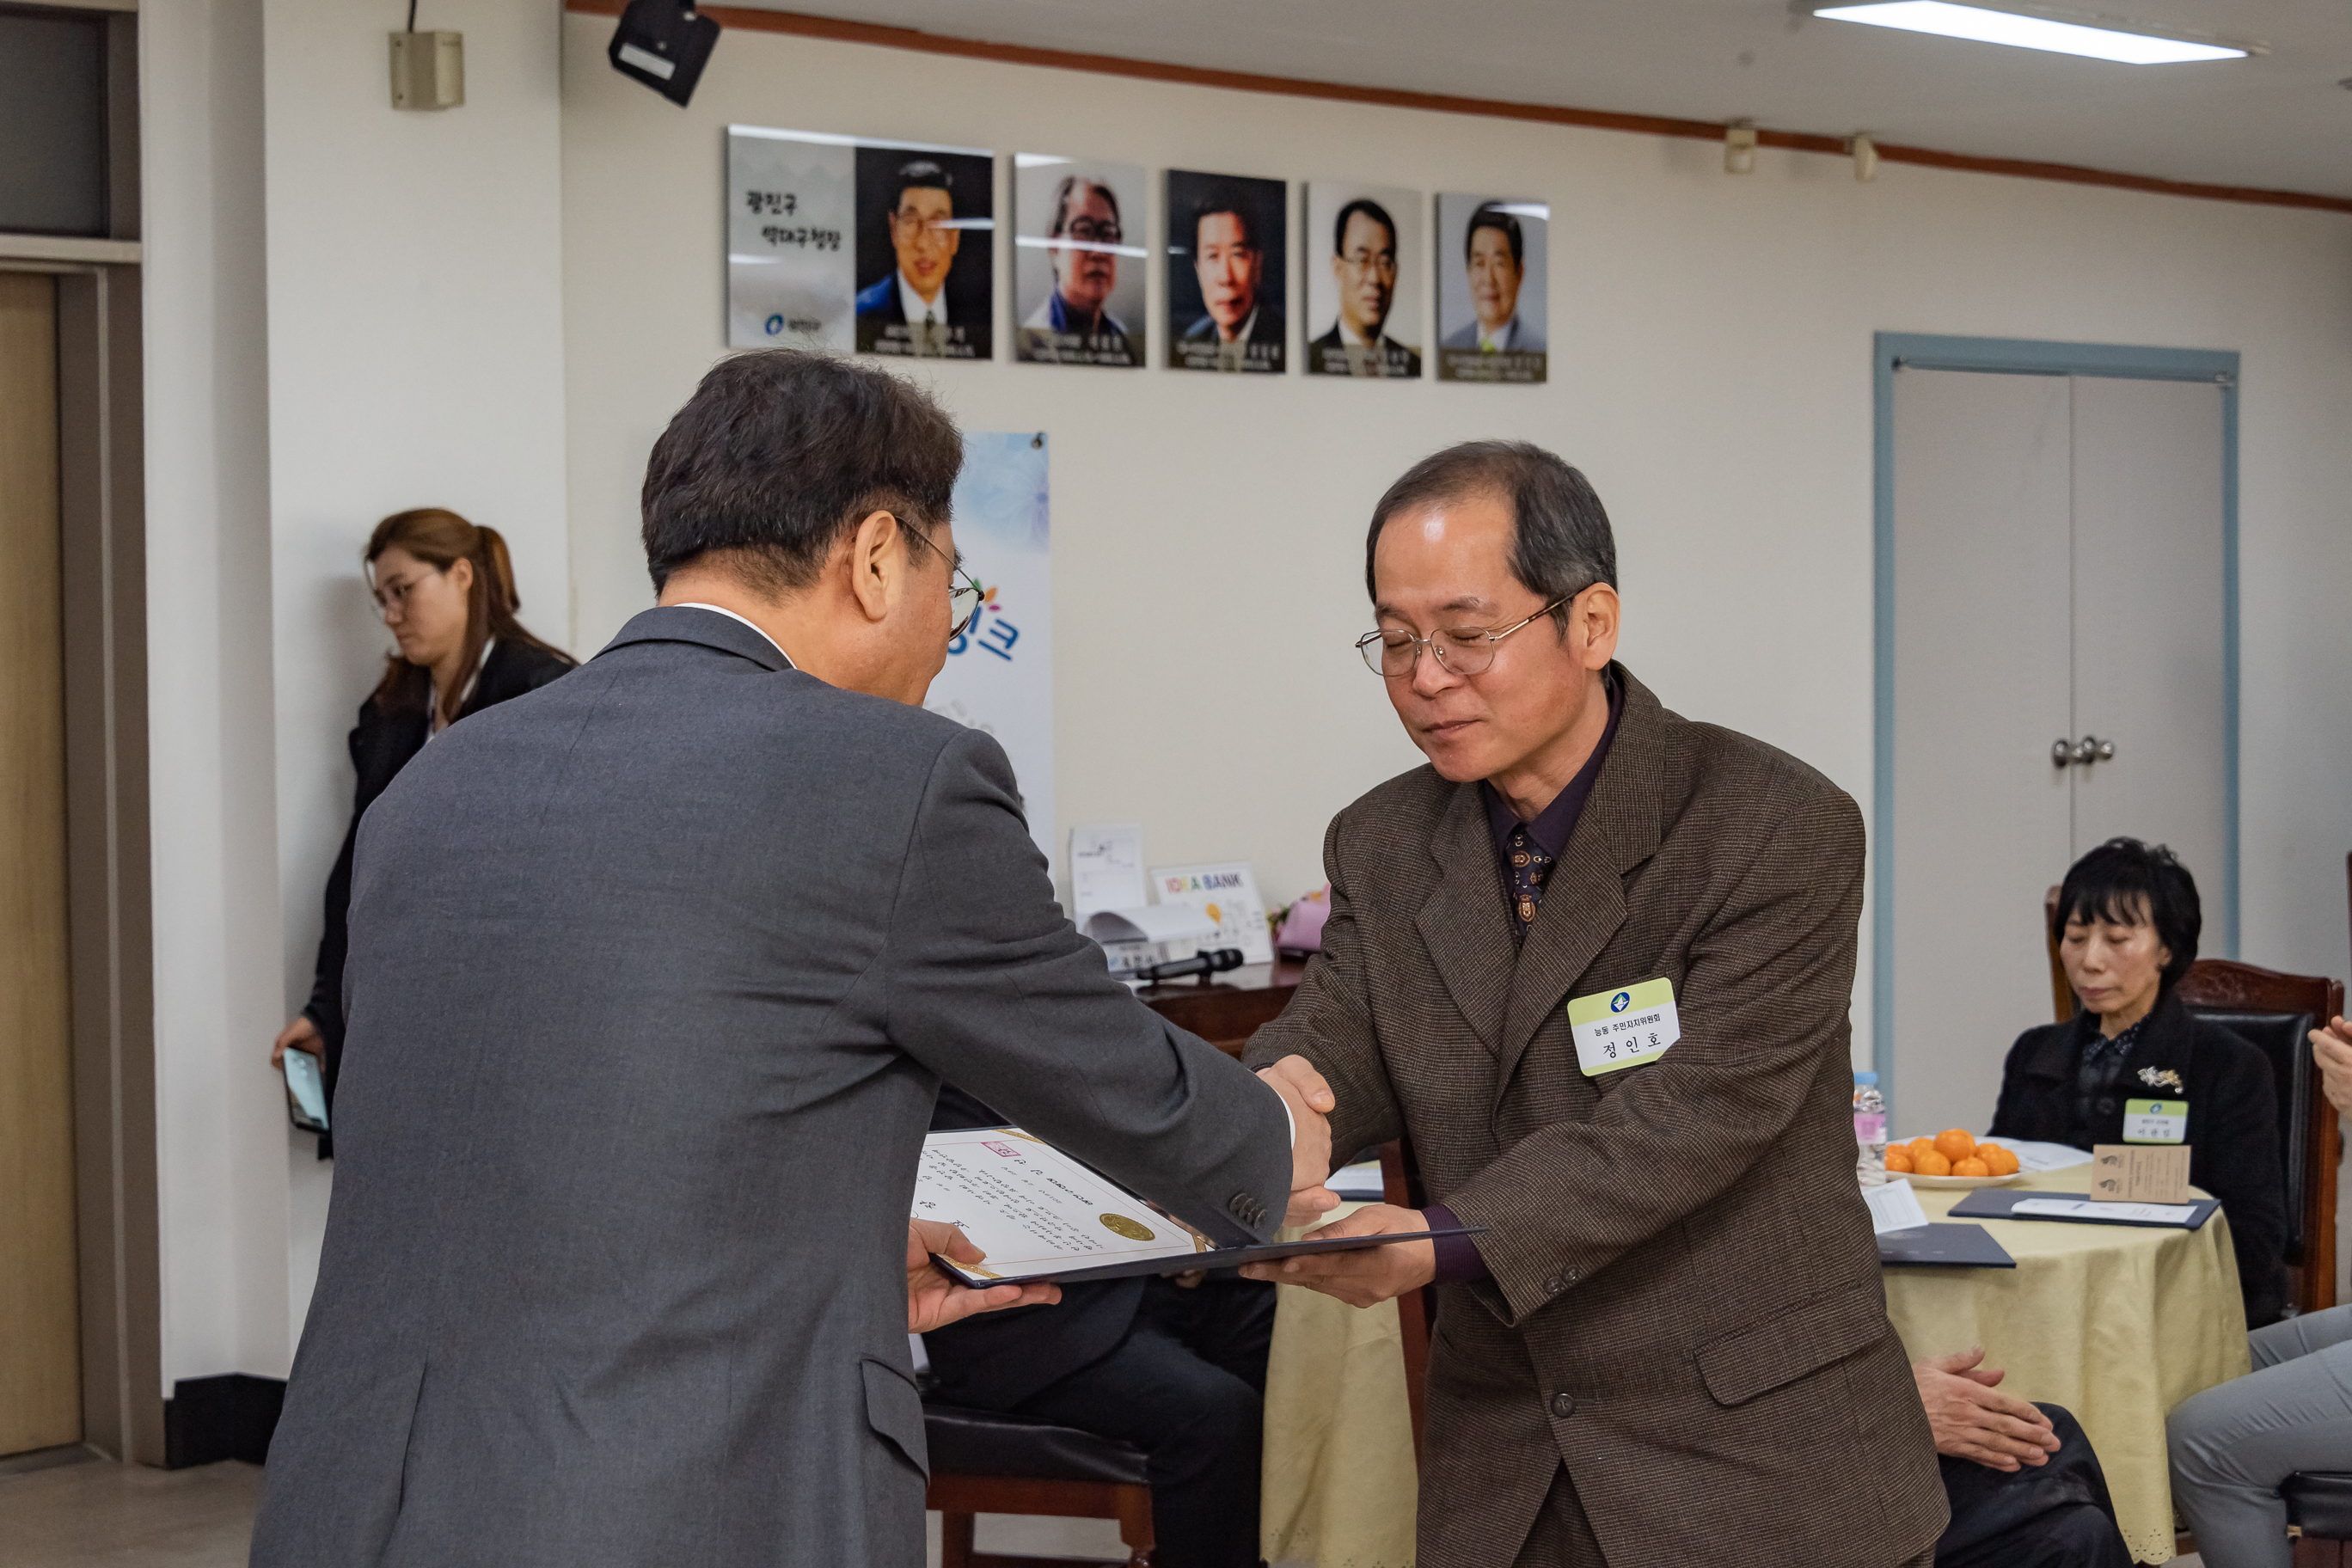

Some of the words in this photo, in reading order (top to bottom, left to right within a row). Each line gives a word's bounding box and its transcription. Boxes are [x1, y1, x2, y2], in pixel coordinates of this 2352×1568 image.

[747, 190, 796, 216] 광진구
[1203, 873, 1243, 891] BANK
[1594, 1026, 1609, 1037] 능동
[1612, 1013, 1661, 1032] 주민자치위원회
